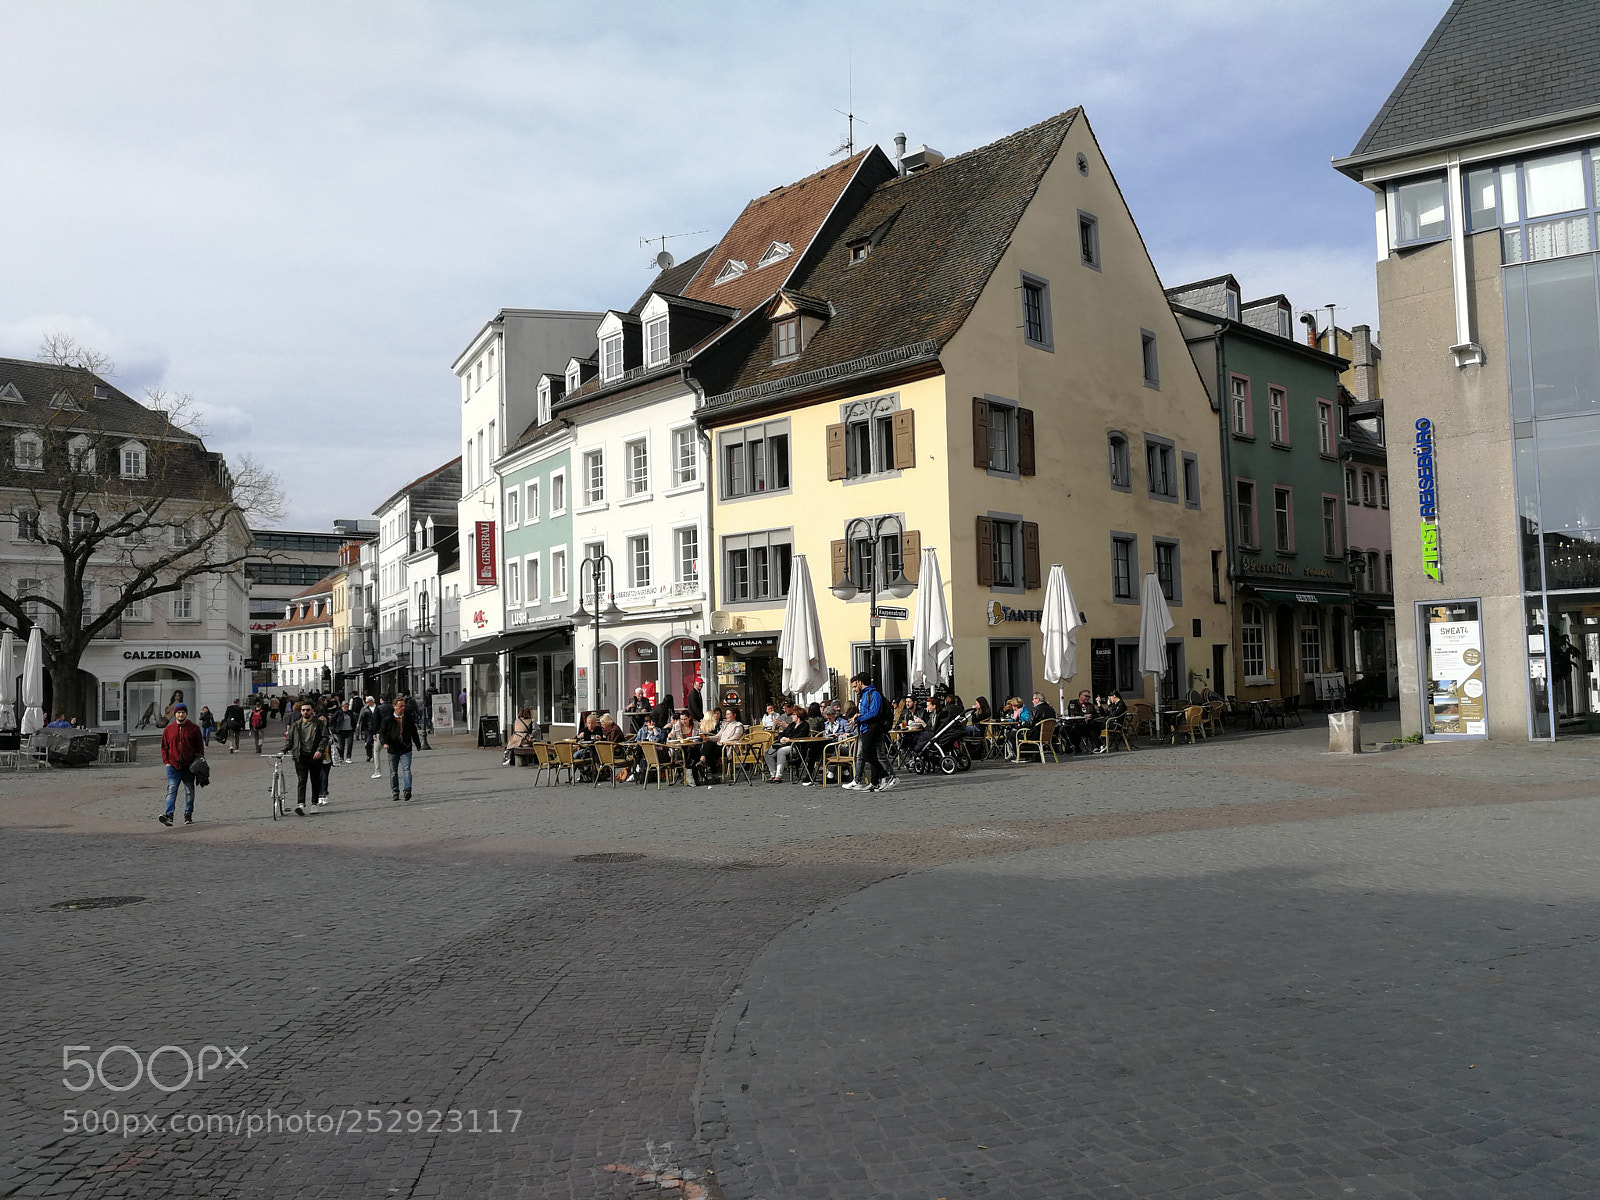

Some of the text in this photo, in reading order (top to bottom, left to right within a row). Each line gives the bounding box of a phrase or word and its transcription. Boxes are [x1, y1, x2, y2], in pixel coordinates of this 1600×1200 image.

[1413, 417, 1439, 581] FIRST REISEBÜRO
[481, 522, 491, 564] GENERALI
[511, 611, 528, 625] LUSH
[123, 650, 201, 660] CALZEDONIA
